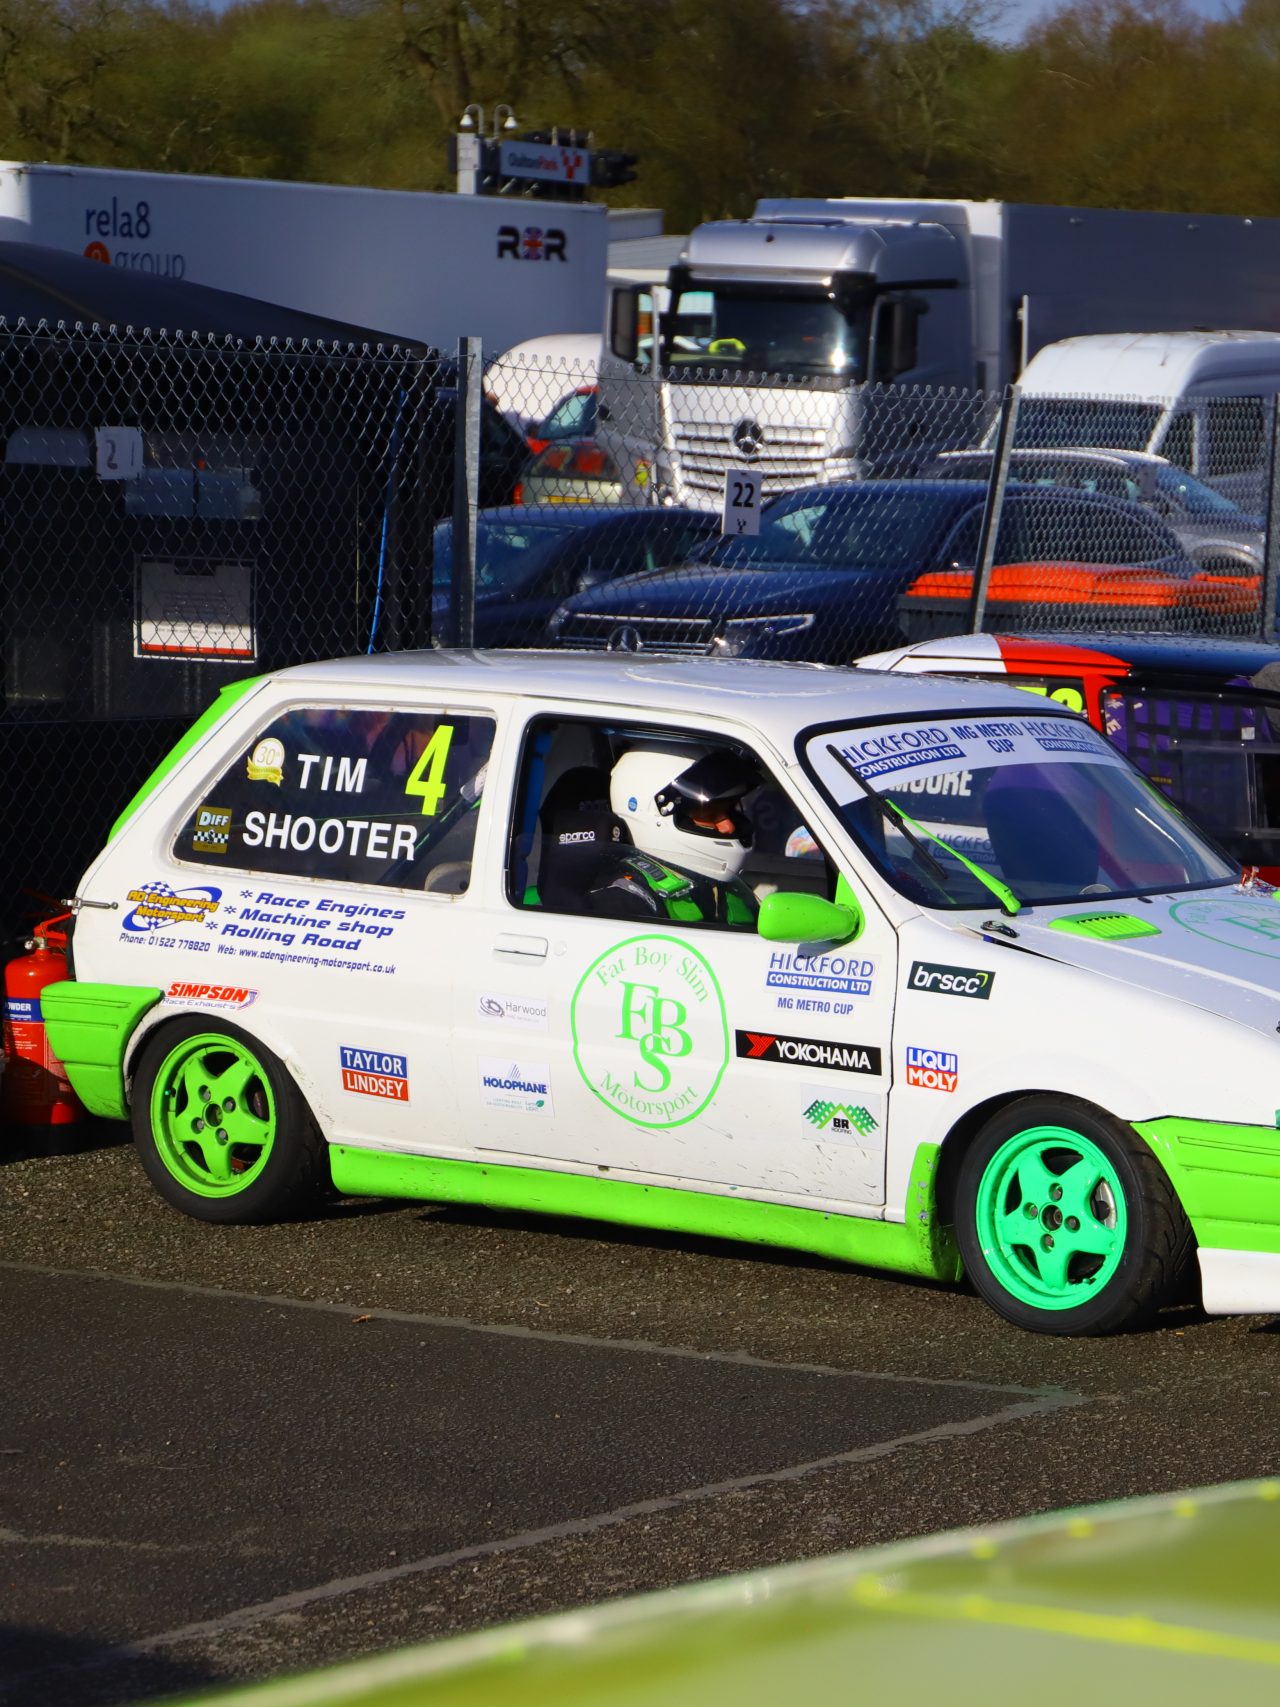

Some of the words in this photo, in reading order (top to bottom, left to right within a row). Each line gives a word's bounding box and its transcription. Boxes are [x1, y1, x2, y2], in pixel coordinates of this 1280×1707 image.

[85, 196, 151, 238] rela8
[732, 482, 755, 508] 22
[950, 724, 980, 740] MG
[974, 722, 1024, 738] METRO
[404, 724, 455, 816] 4
[856, 750, 942, 778] ONSTRUCTION
[940, 745, 961, 757] LTD
[986, 738, 1016, 753] CUP
[297, 754, 368, 793] TIM
[199, 811, 230, 827] DIFF
[242, 811, 418, 861] SHOOTER
[559, 830, 595, 844] sparco
[126, 889, 147, 902] AD
[146, 892, 220, 913] Engineering
[135, 904, 206, 923] Motorsport
[255, 892, 311, 908] Race
[315, 899, 407, 920] Engines
[239, 907, 332, 930] Machine
[336, 920, 395, 939] shop
[220, 923, 296, 947] Rolling
[301, 933, 362, 951] Road
[118, 932, 146, 945] Phone:
[148, 936, 176, 949] 01522
[178, 939, 211, 952] 778820
[217, 944, 237, 956] Web:
[239, 947, 397, 975] www.adengineering-motorsport.co.uk
[769, 952, 874, 978] HICKFORD
[596, 956, 627, 987] Fat
[634, 946, 673, 973] Boy
[675, 956, 710, 1004] Slim
[768, 973, 849, 991] CONSTRUCTION
[850, 982, 870, 993] LTD
[913, 965, 981, 994] brscc
[168, 983, 249, 1003] SIMPSON
[777, 997, 794, 1009] MG
[795, 998, 831, 1014] METRO
[833, 1002, 854, 1015] CUP
[505, 1002, 547, 1017] Harwood
[343, 1049, 404, 1075] TAYLOR
[775, 1040, 872, 1070] YOKOHAMA
[908, 1048, 956, 1072] LIQUI
[346, 1072, 404, 1098] LINDSEY
[483, 1076, 548, 1095] HOLOPHANE
[908, 1067, 957, 1091] MOLY
[600, 1070, 699, 1122] Motorsport
[832, 1117, 850, 1130] BR
